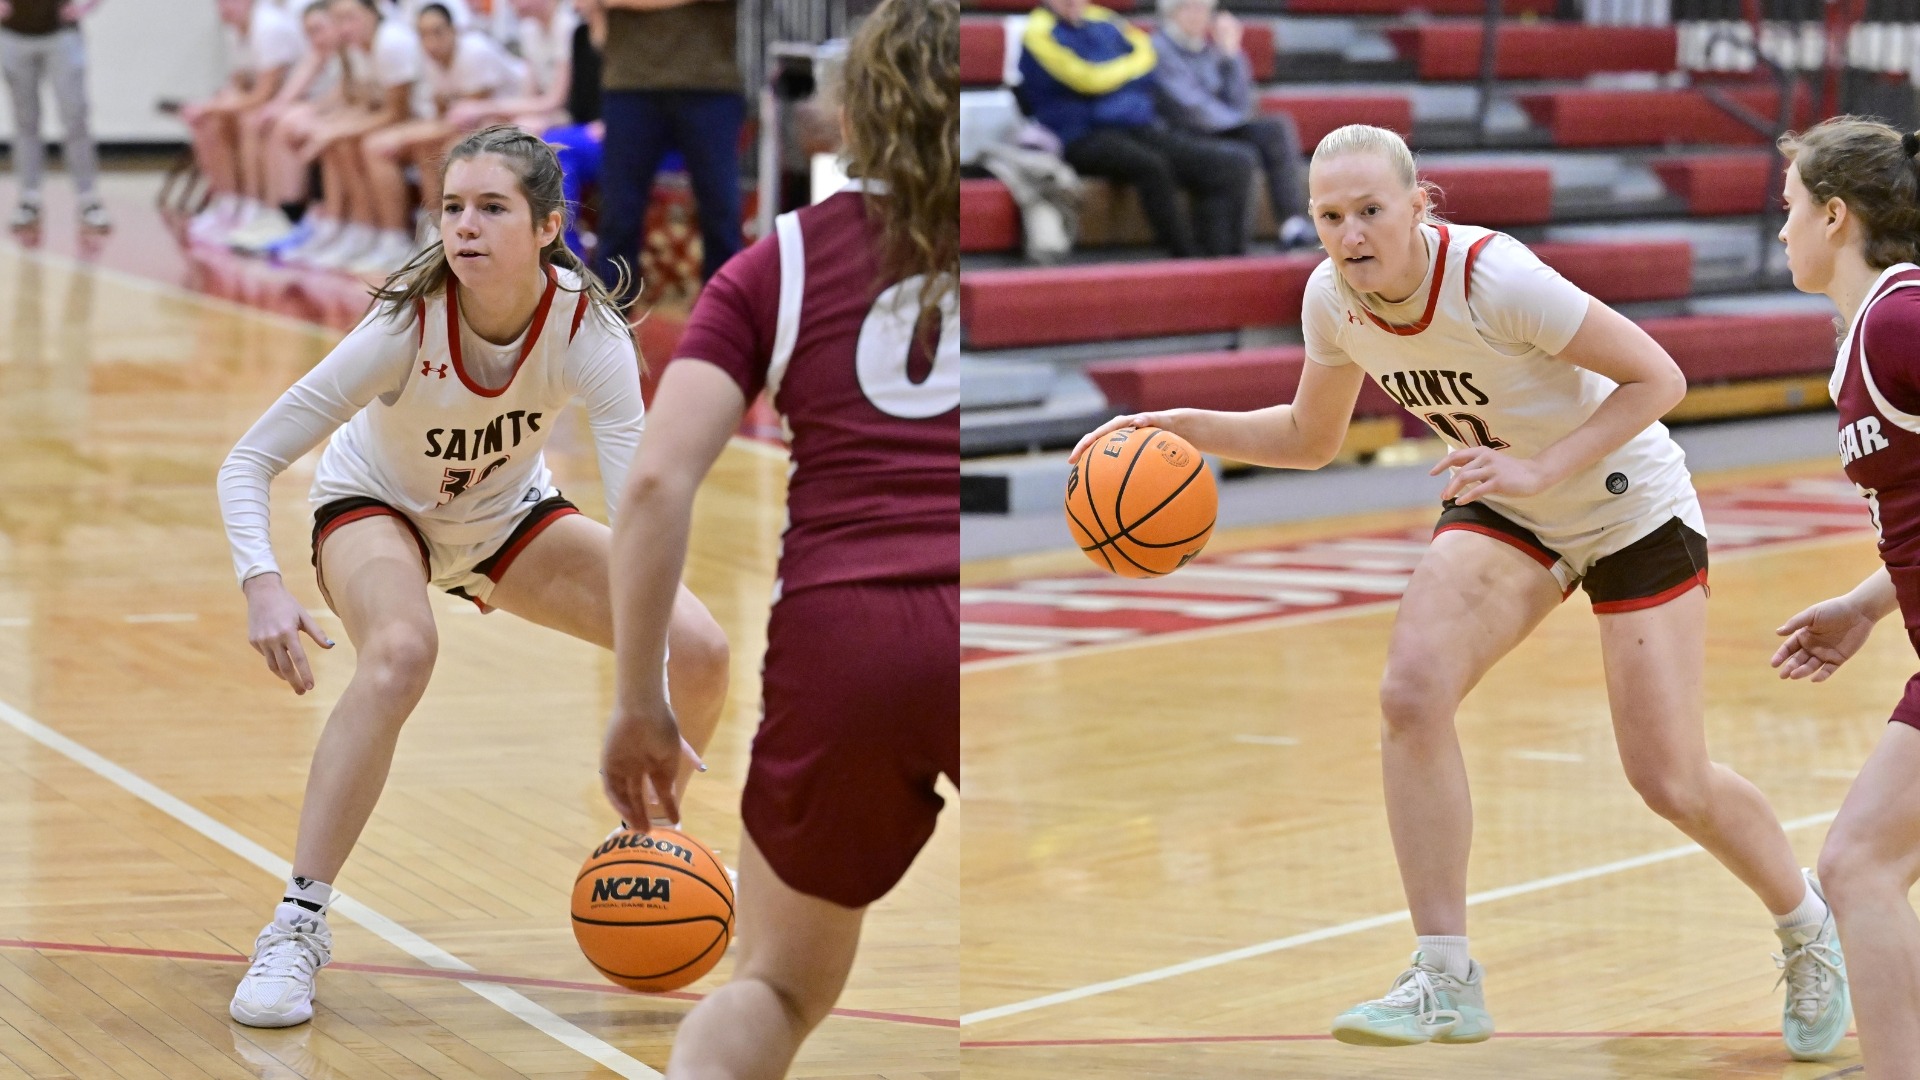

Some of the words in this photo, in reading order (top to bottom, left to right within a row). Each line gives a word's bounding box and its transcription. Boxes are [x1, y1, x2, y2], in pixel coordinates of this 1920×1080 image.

[1381, 370, 1489, 408] SAINTS
[424, 410, 543, 461] SAINTS
[591, 876, 670, 902] NCAA
